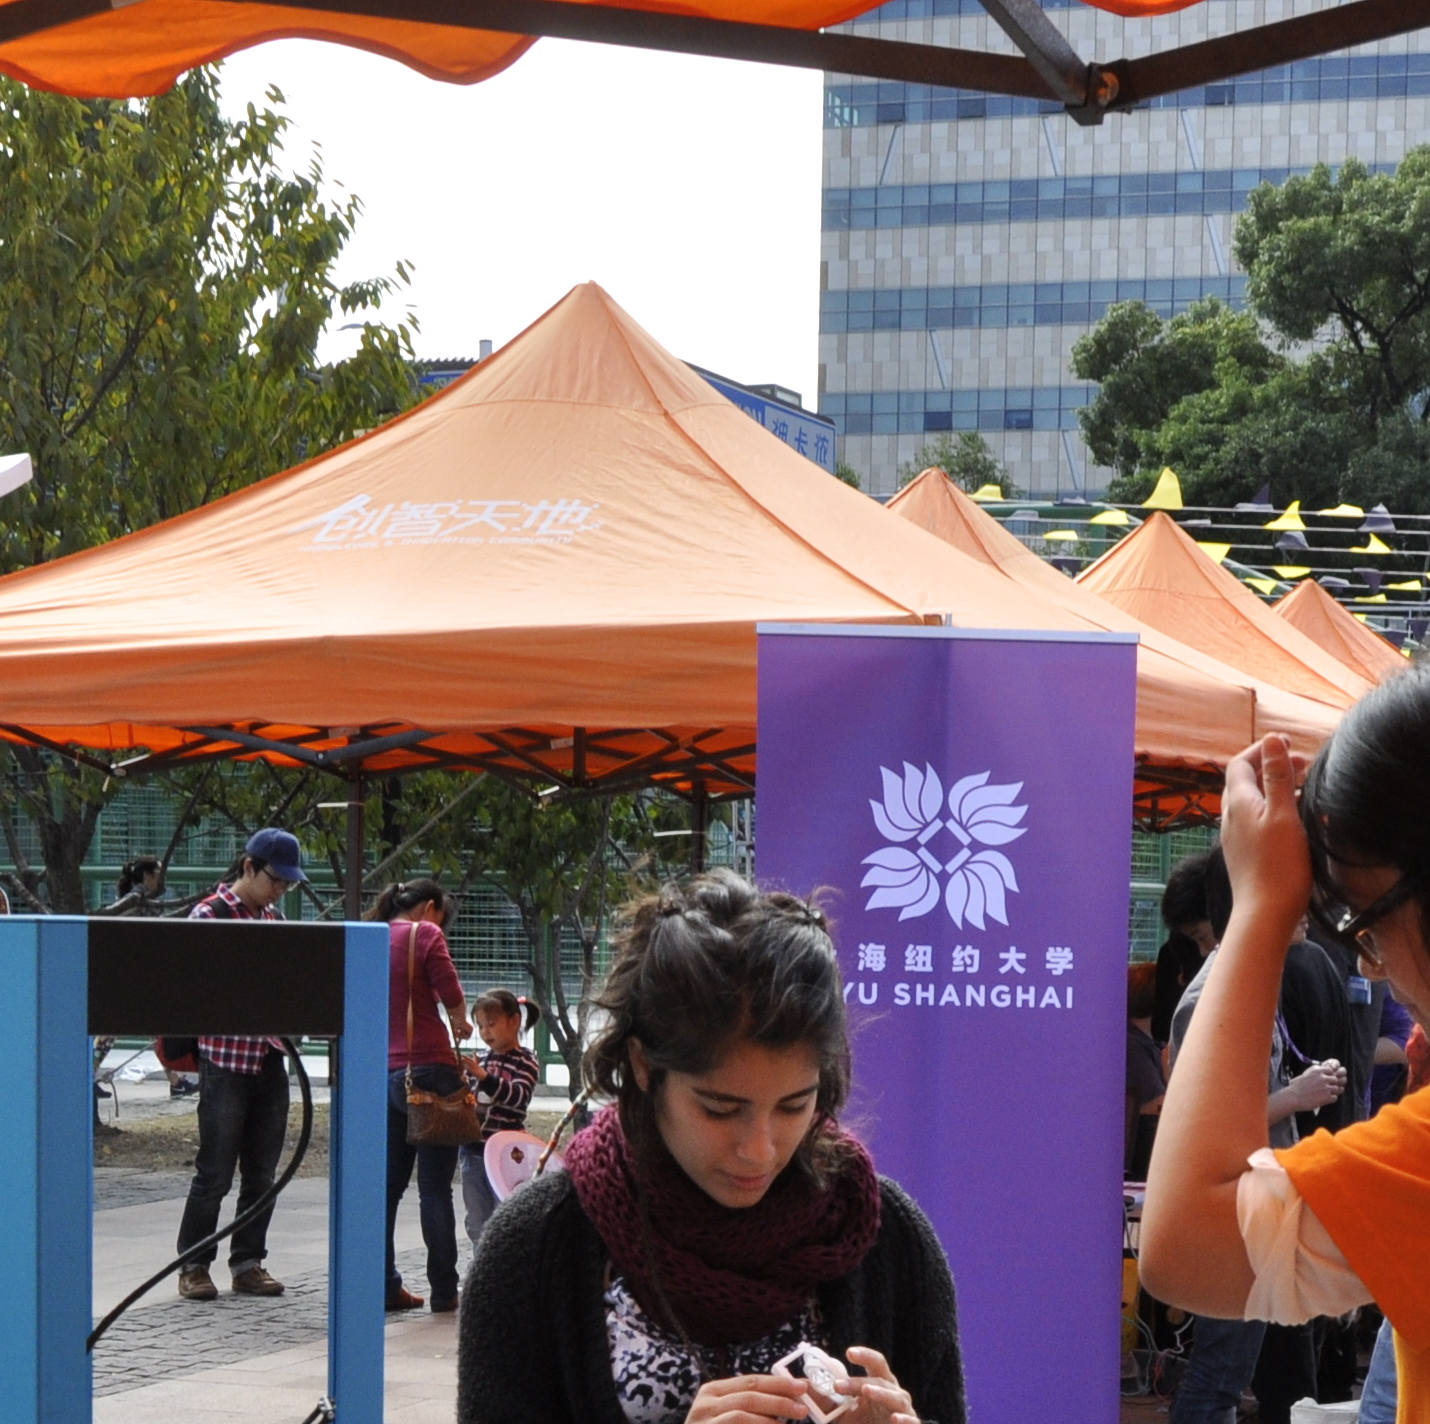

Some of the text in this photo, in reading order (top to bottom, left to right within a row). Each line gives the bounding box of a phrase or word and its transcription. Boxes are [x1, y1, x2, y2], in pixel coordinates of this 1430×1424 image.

[287, 493, 605, 542] 创智天地
[400, 535, 485, 547] INNOVATION
[489, 535, 573, 546] COMMUNITY
[833, 942, 1074, 976] 海纽约大学
[842, 981, 1074, 1010] YU SHANGHAI
